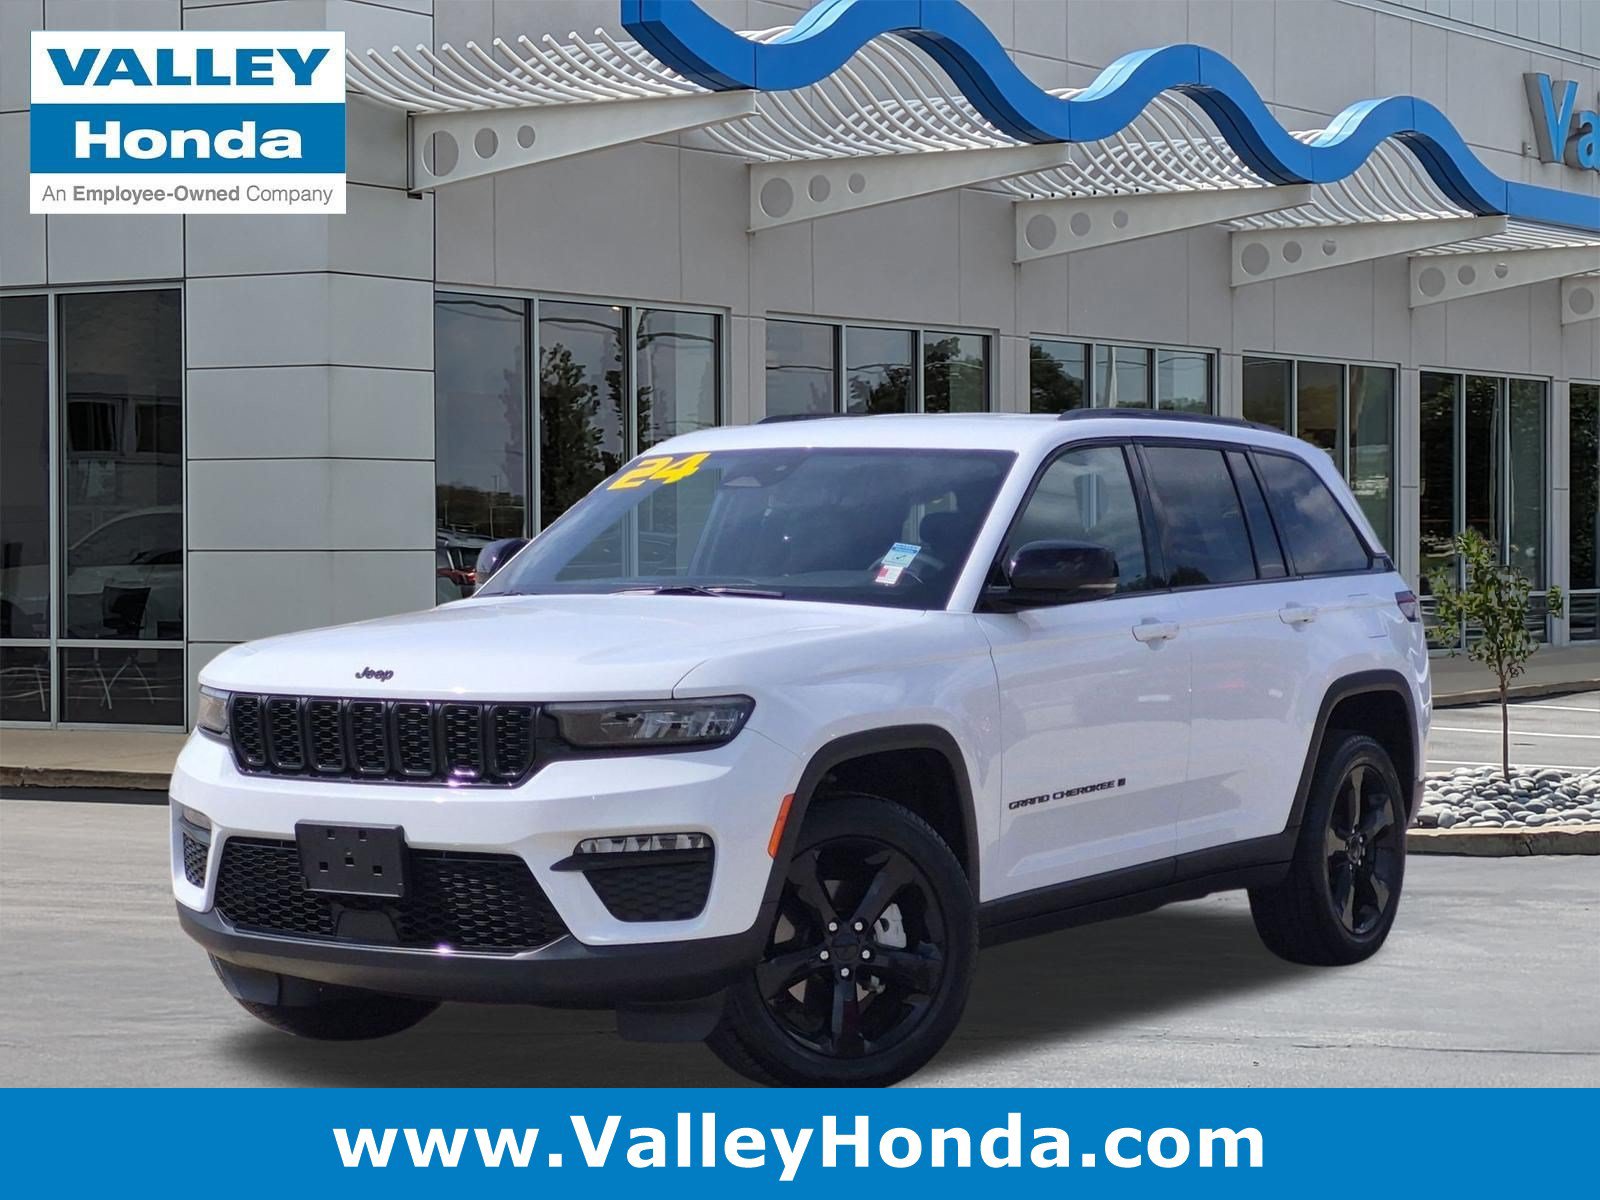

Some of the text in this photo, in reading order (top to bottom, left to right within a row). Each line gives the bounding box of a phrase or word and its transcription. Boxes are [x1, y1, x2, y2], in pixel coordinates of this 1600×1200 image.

[606, 452, 711, 490] 24
[355, 666, 394, 682] Jeep
[1008, 780, 1115, 810] GRAND CHEROKEE
